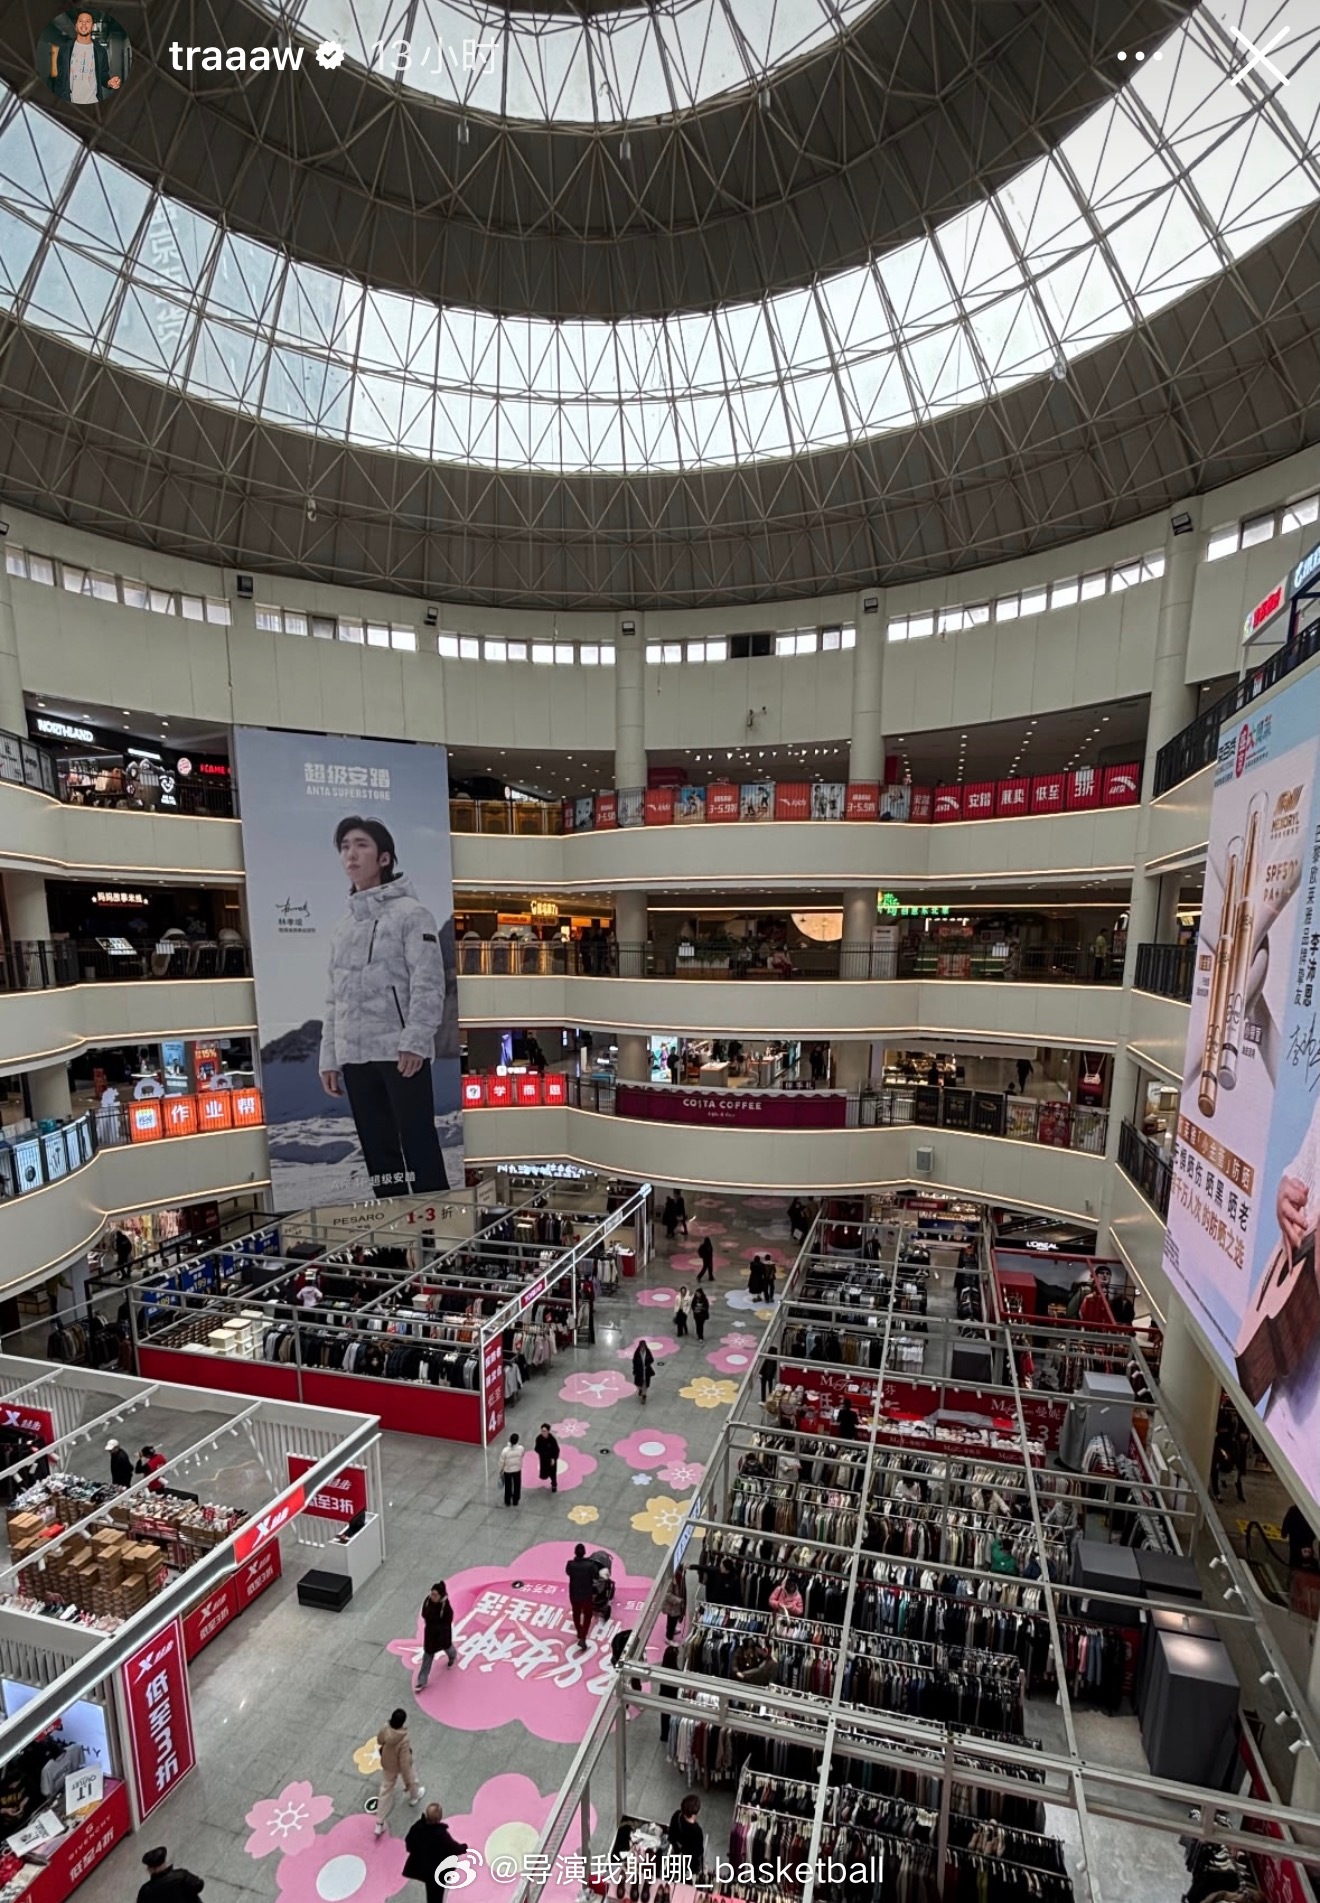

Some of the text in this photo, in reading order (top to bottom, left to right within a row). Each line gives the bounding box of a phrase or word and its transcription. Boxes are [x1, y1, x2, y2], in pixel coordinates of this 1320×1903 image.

[37, 719, 94, 742] NORTHLAND
[304, 763, 390, 788] 超级安踏
[306, 785, 391, 800] ANTA SUPERSTORE
[171, 1097, 255, 1124] 作业帮
[719, 1101, 762, 1110] COFFEE
[333, 1212, 385, 1226] PESARO
[406, 1207, 453, 1224] 1-3 折
[145, 1669, 179, 1792] 低至3折
[68, 1815, 111, 1861] GIVENCHY
[69, 1827, 114, 1882] 低至4折
